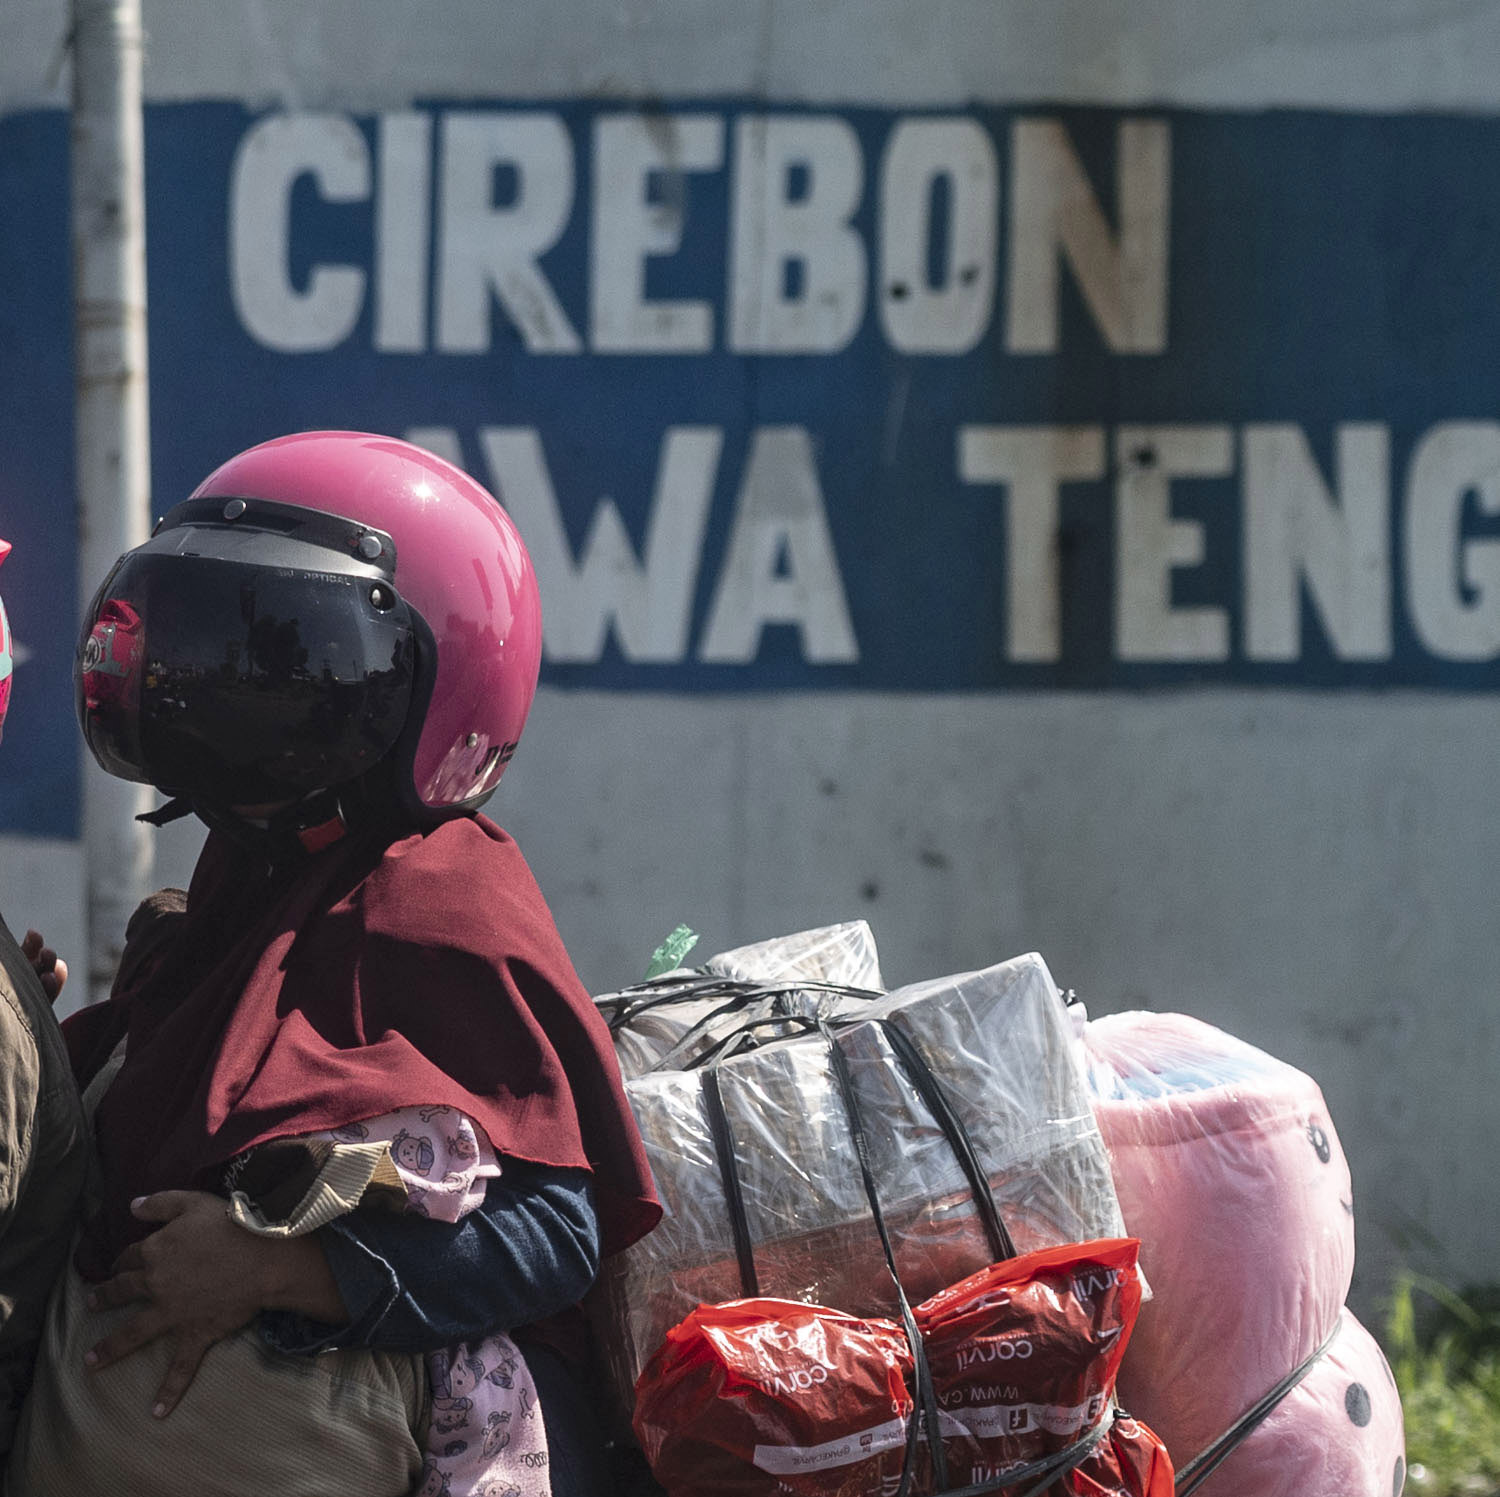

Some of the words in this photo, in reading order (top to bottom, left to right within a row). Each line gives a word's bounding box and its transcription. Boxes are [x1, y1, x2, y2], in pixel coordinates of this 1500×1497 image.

[229, 112, 1170, 354] CIREBON
[401, 426, 860, 665] WA
[956, 1340, 1033, 1372] carvil
